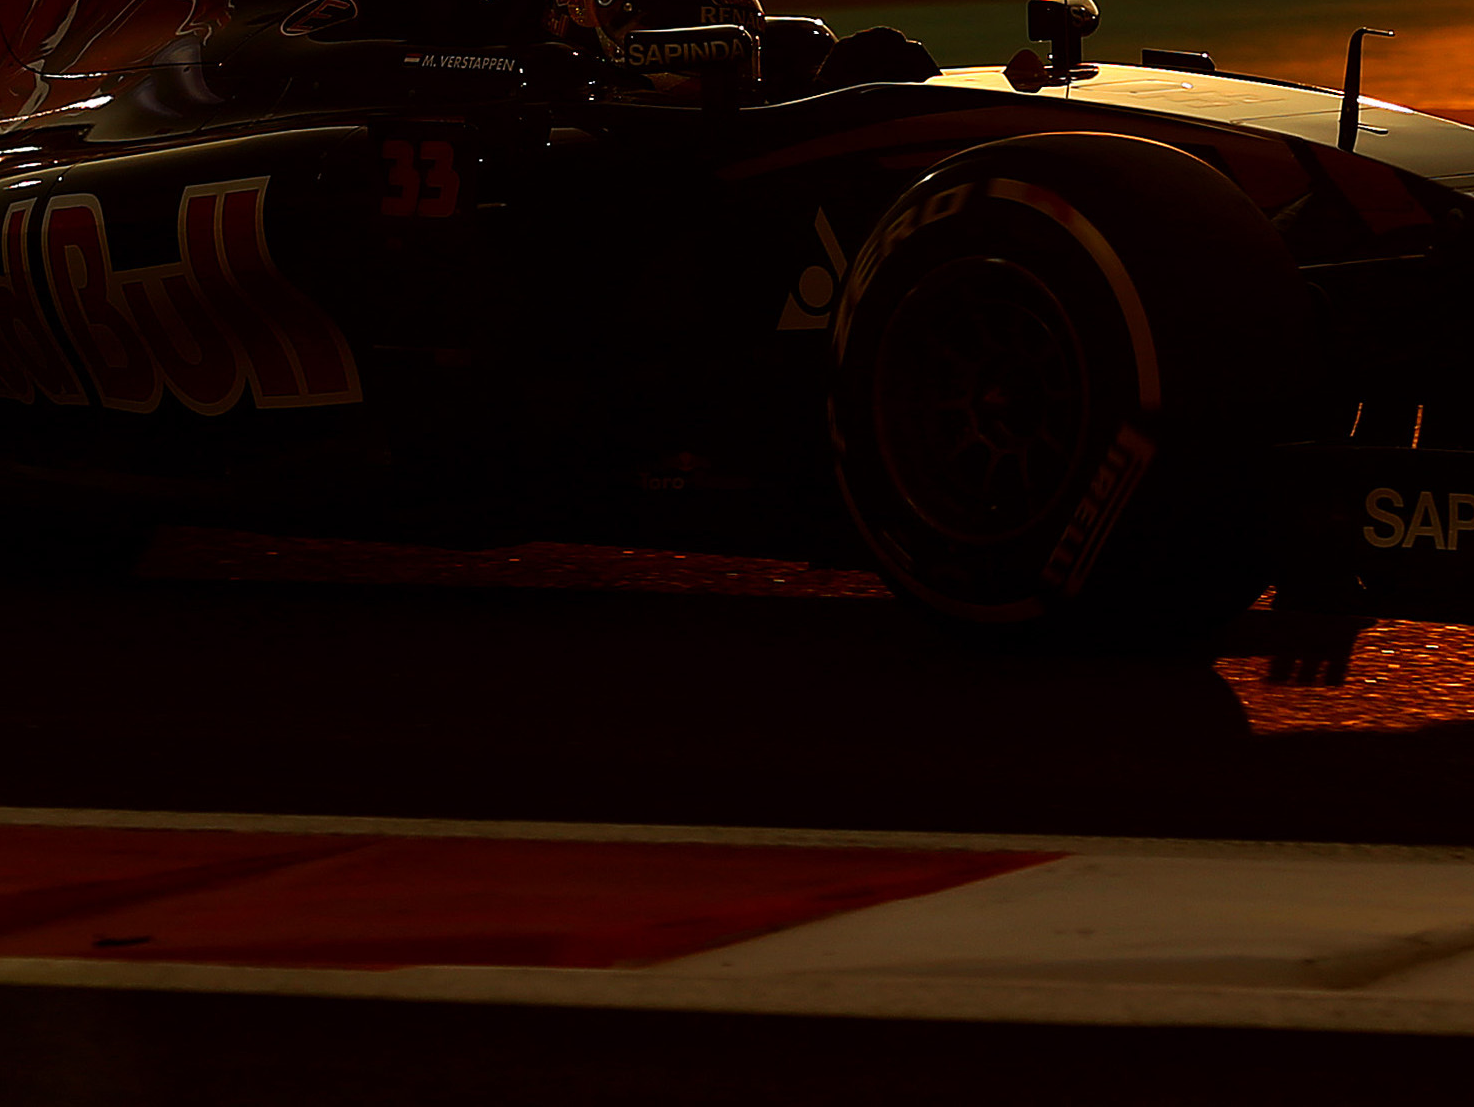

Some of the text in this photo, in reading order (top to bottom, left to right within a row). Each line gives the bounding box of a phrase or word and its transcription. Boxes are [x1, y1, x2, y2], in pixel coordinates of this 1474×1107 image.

[421, 54, 515, 72] M. VERSTAPPEN
[628, 38, 749, 67] SAPINDA
[380, 140, 460, 218] 33
[40, 174, 365, 417] Bull
